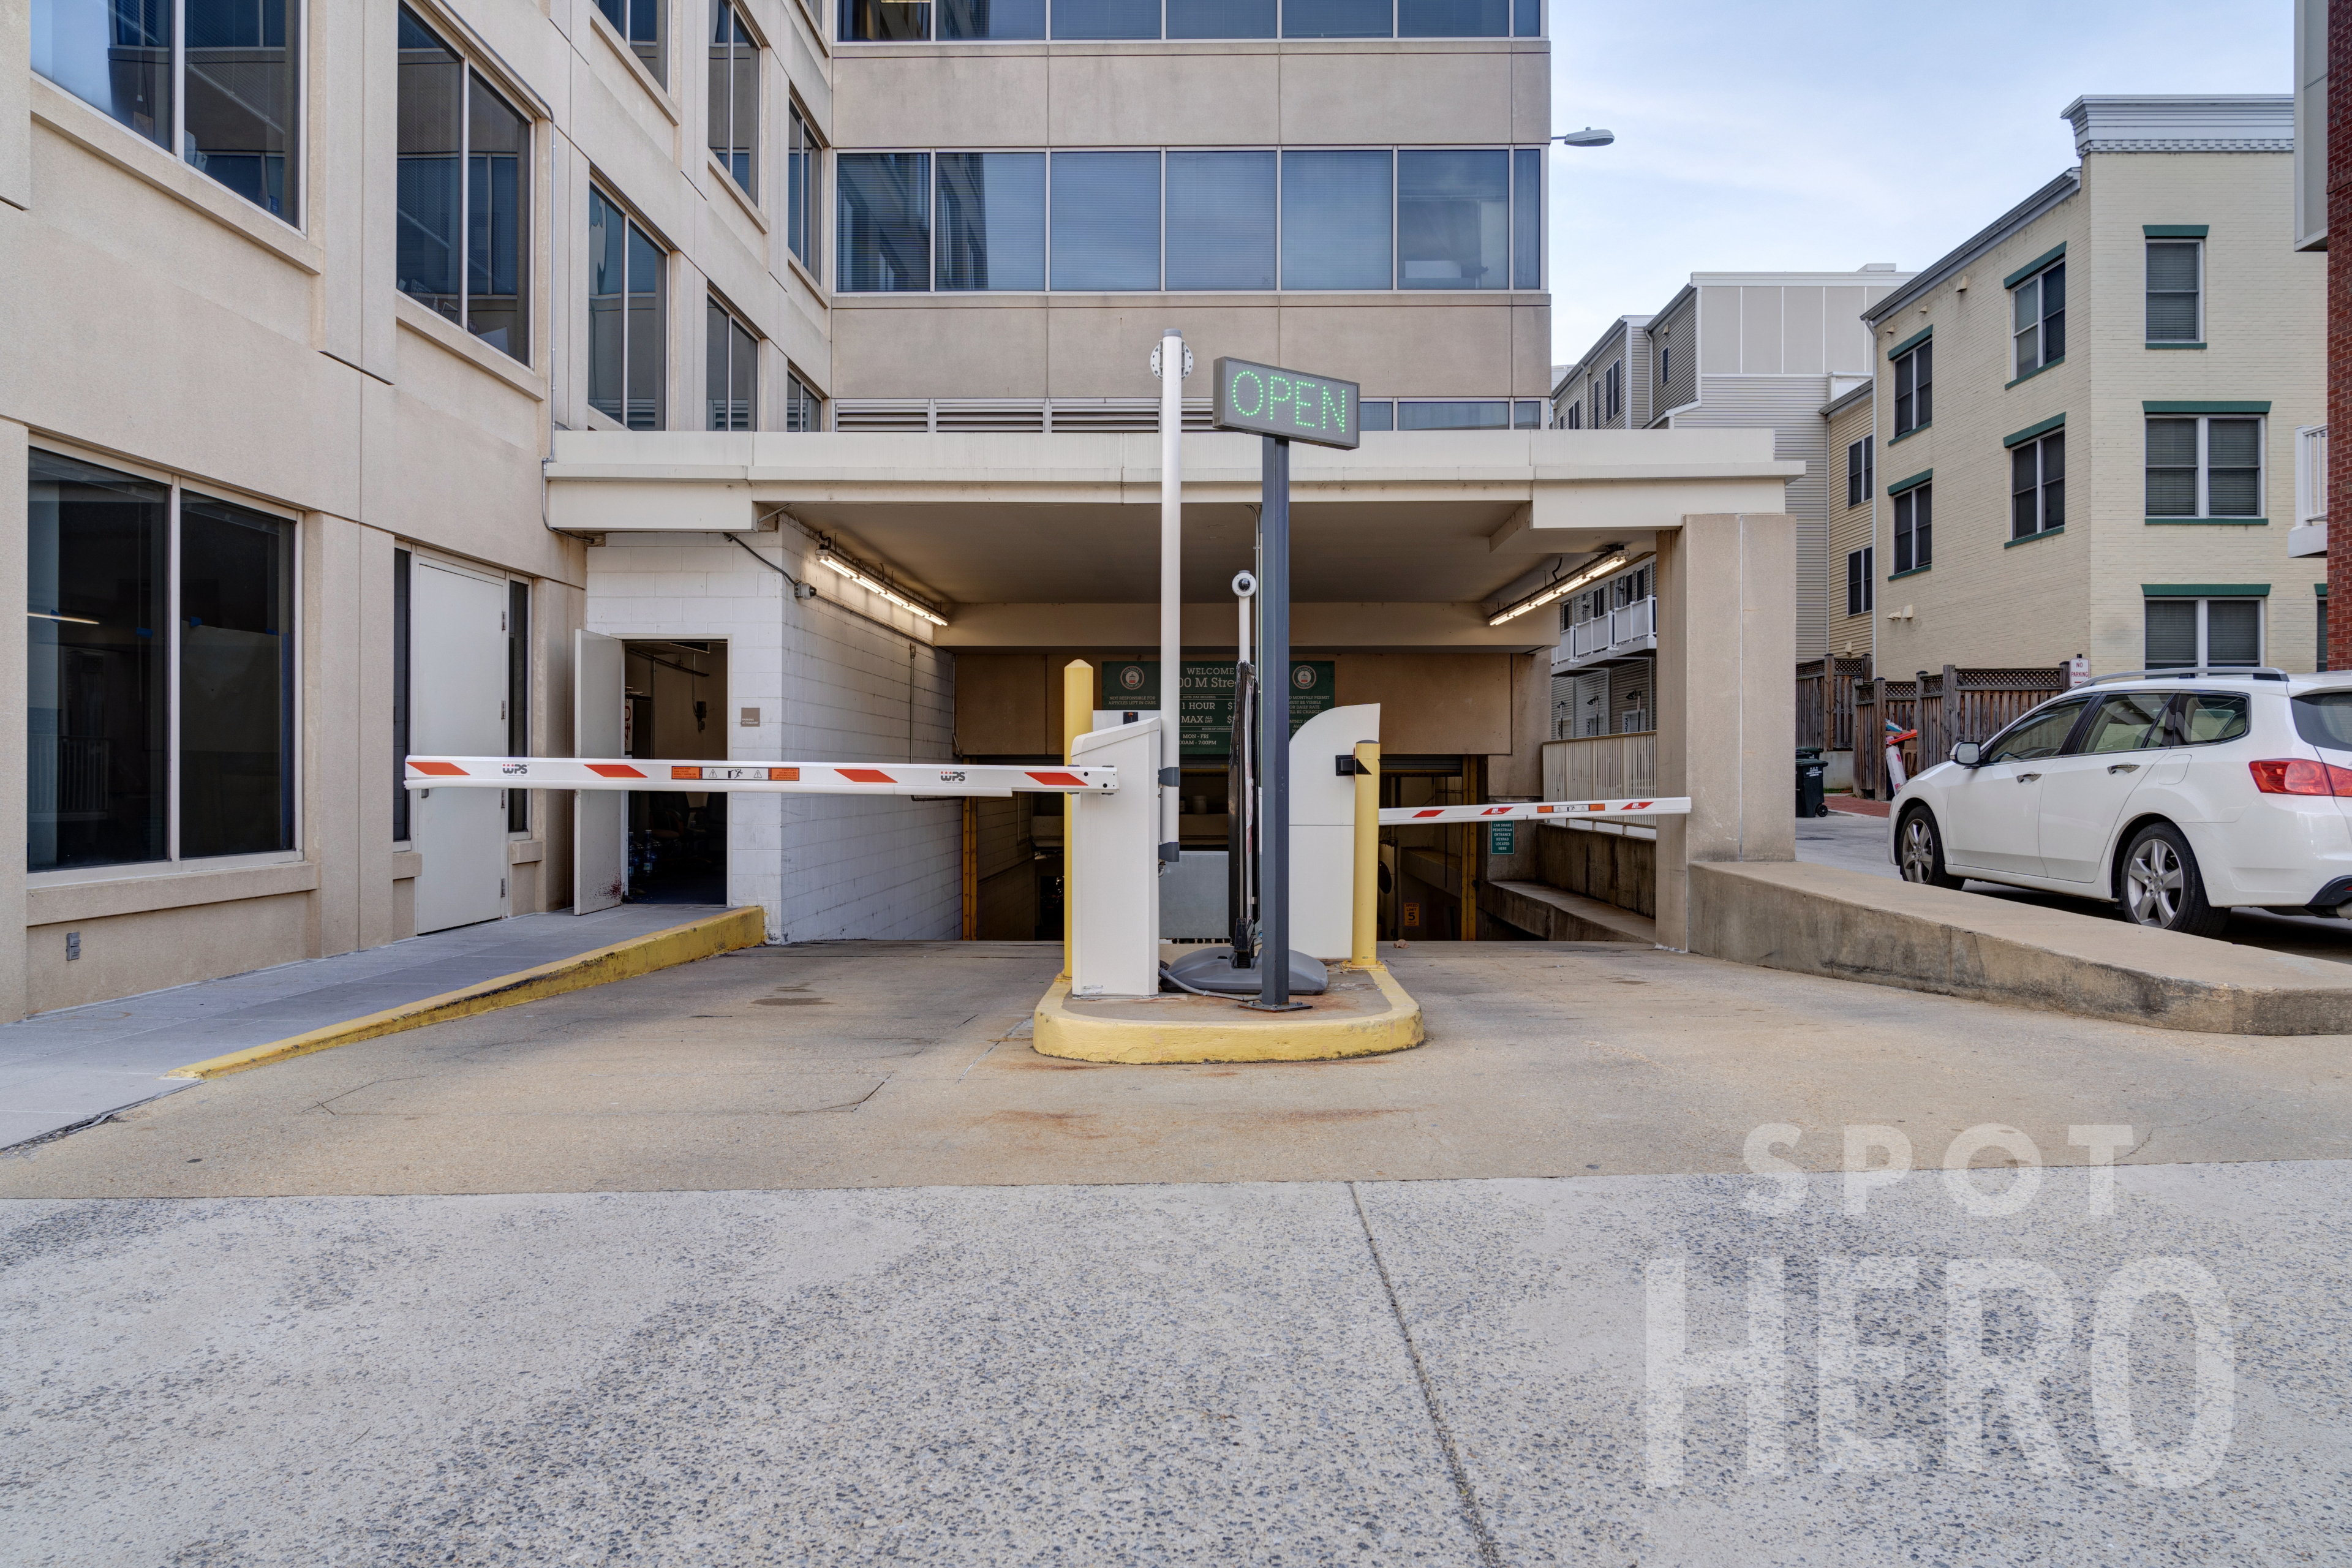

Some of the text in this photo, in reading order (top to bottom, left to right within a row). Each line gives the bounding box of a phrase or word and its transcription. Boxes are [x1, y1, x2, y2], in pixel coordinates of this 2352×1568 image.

[1232, 371, 1346, 432] OPEN
[1195, 677, 1208, 687] M
[1211, 677, 1235, 688] Stre
[502, 763, 528, 775] WPS
[940, 771, 966, 782] WPS
[1408, 911, 1415, 921] 5
